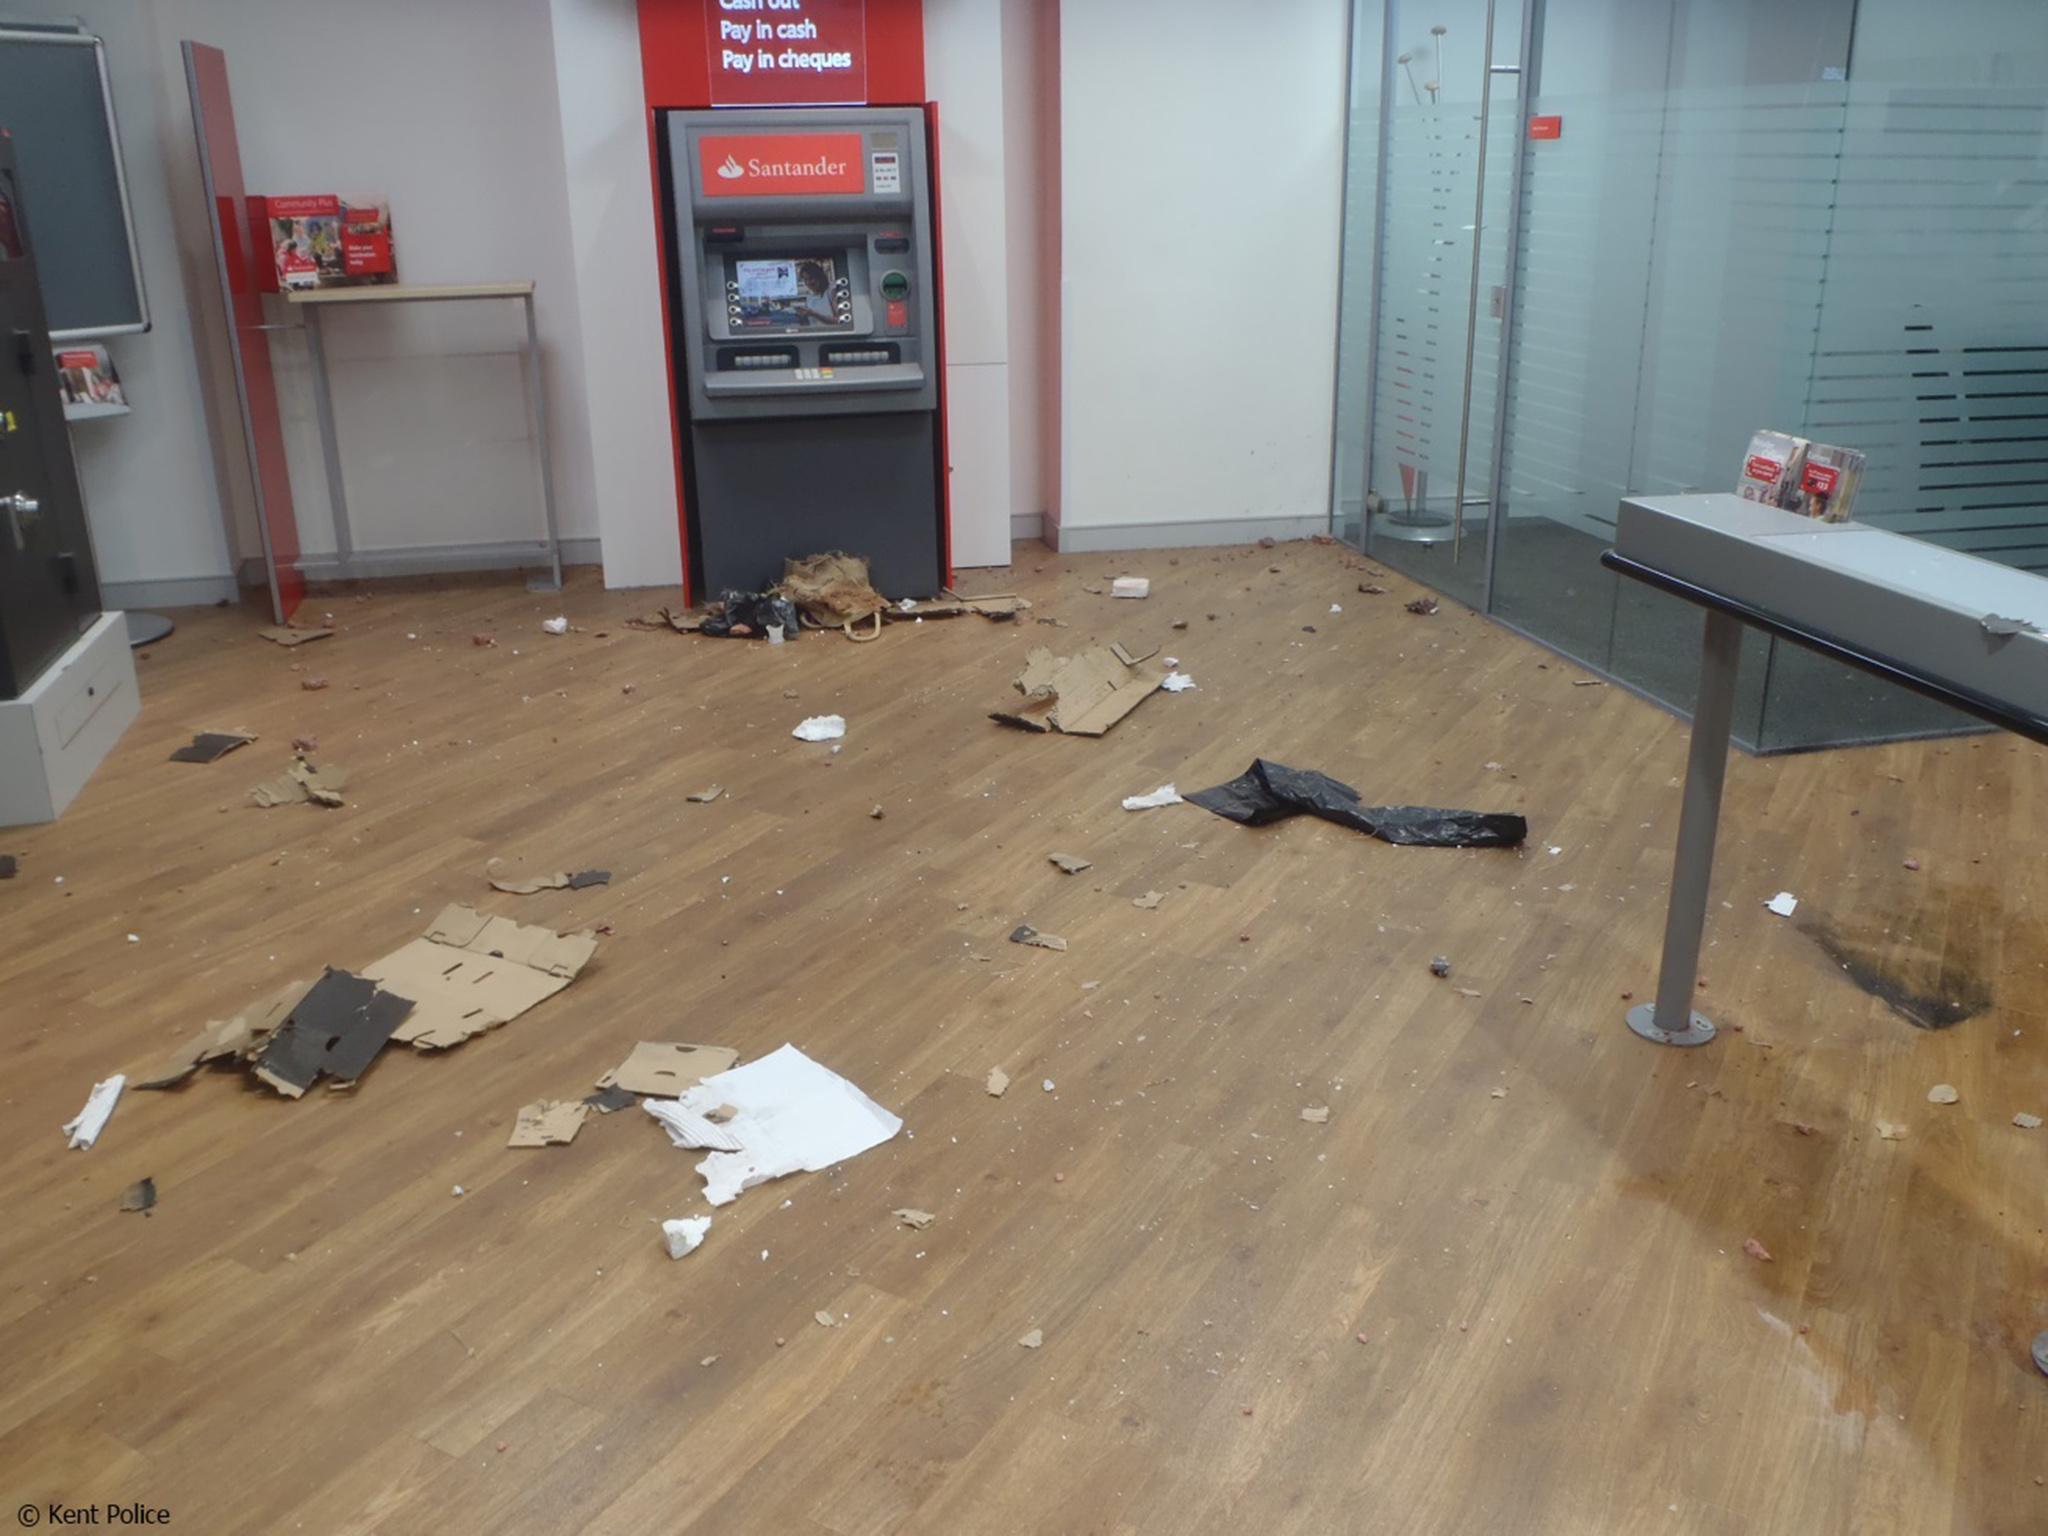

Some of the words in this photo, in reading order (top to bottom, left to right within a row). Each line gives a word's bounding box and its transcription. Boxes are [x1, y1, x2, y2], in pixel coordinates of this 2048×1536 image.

[720, 19, 753, 43] Pay
[756, 18, 773, 39] in
[776, 18, 817, 39] cash
[722, 49, 754, 73] Pay
[757, 48, 775, 69] in
[778, 48, 852, 72] cheques
[747, 156, 847, 178] Santander
